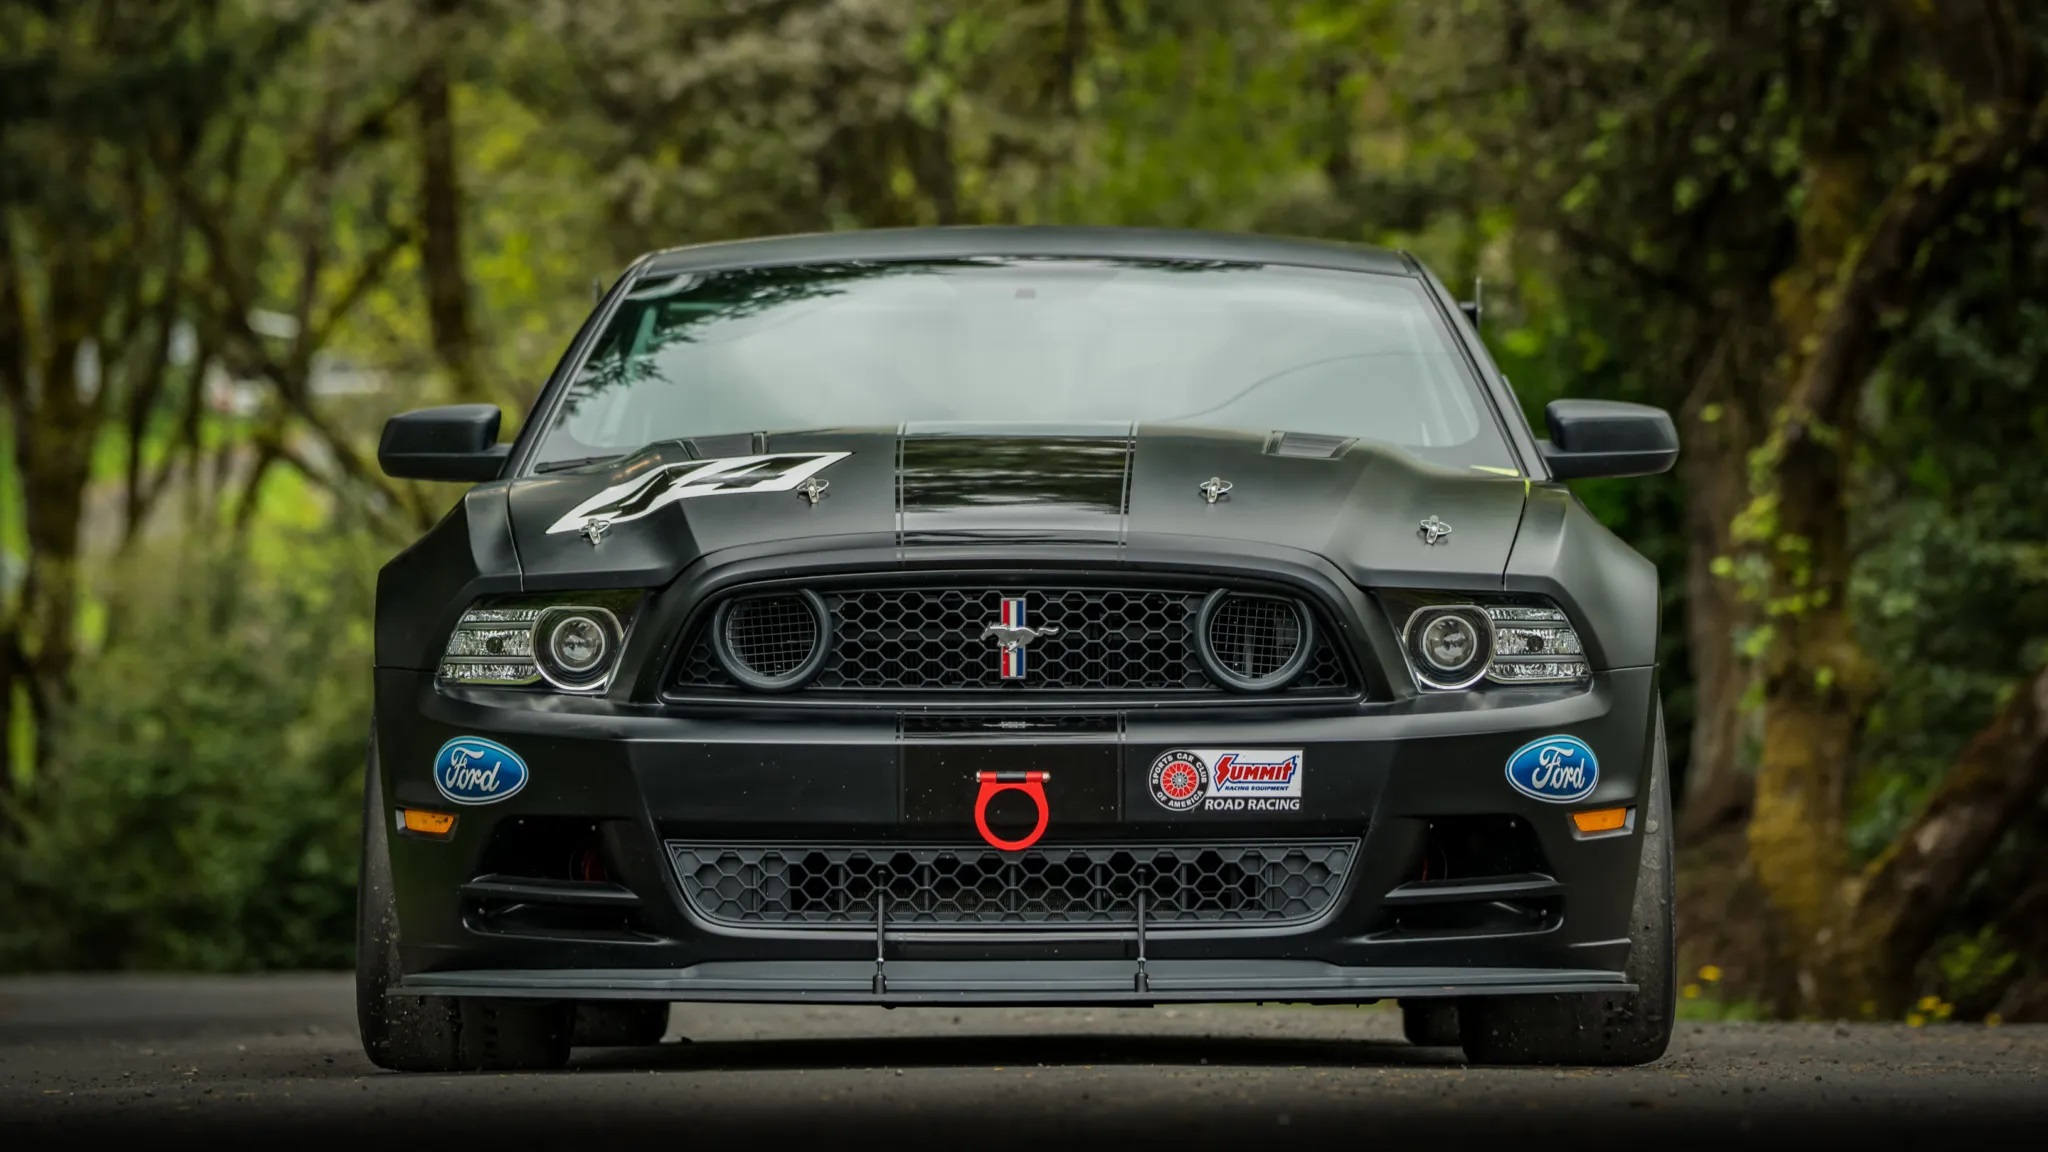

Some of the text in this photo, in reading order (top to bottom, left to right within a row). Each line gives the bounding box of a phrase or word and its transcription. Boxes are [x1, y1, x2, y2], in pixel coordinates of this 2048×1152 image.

[445, 746, 502, 792] Ford
[1152, 752, 1207, 784] SPORTS CAR CLUB
[1531, 745, 1586, 789] Ford
[1156, 790, 1204, 808] OF AMERICA
[1204, 798, 1300, 811] ROAD RACING
